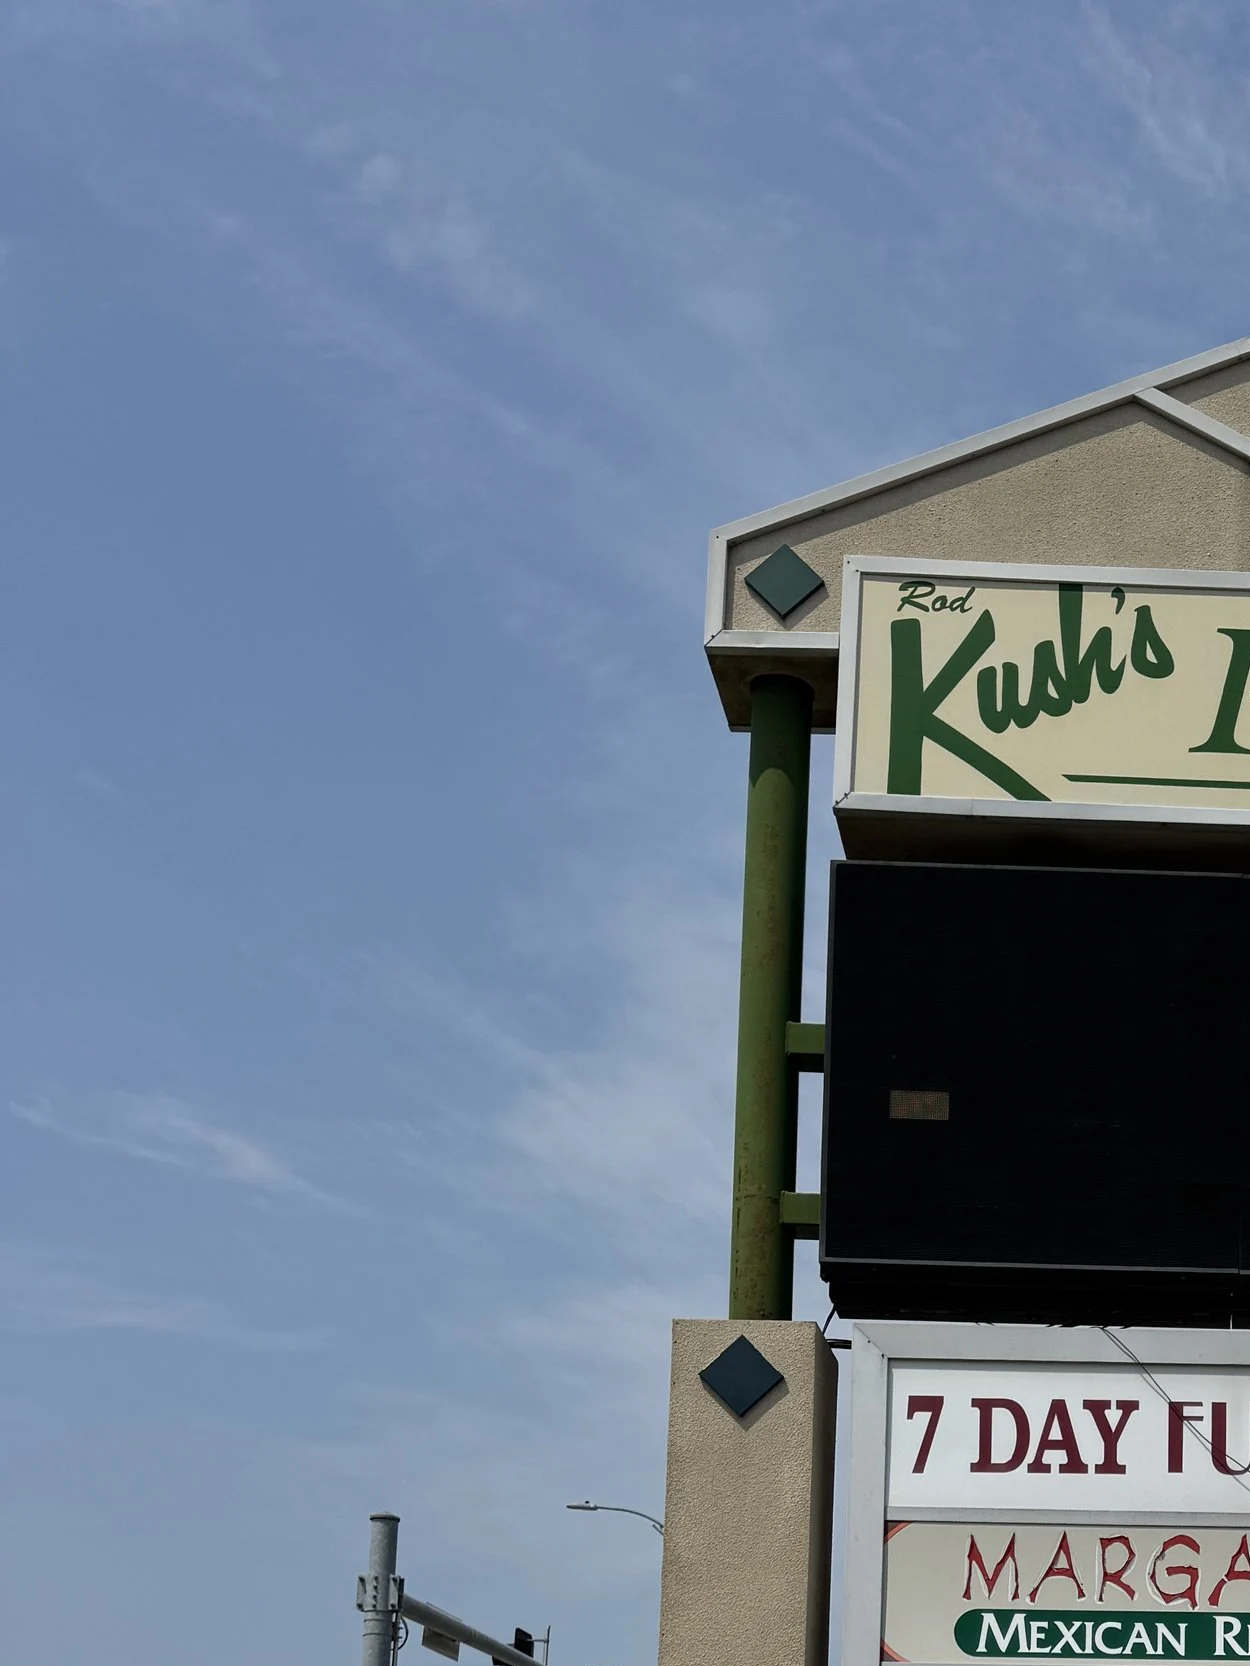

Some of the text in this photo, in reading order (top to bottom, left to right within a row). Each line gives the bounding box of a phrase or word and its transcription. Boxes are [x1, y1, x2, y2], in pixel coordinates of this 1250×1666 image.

[897, 581, 976, 613] Rod
[887, 583, 1175, 802] Kush's
[906, 1395, 945, 1474] 7
[969, 1396, 1140, 1475] DAY
[976, 1613, 1189, 1658] MEXICAN
